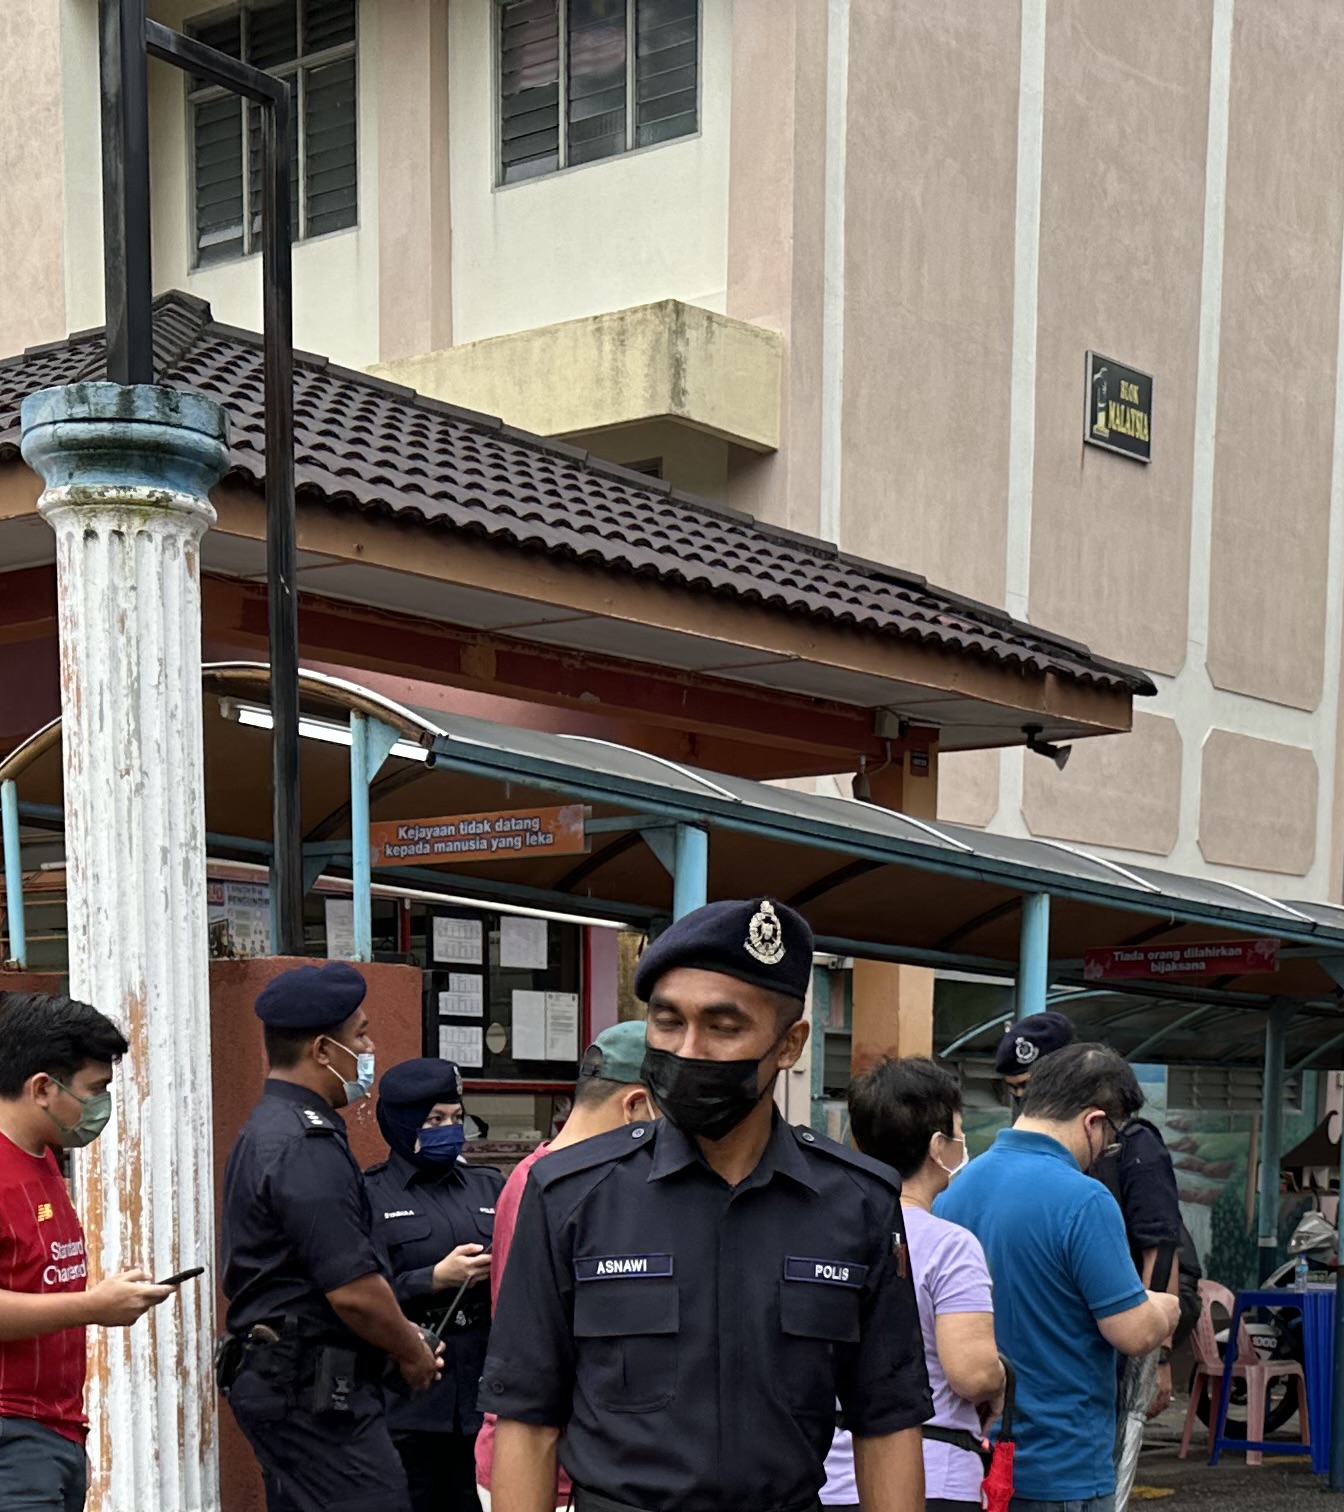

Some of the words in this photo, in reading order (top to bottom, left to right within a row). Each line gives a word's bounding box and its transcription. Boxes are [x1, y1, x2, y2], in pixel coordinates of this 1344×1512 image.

[1108, 400, 1149, 442] MALAYSIA
[398, 824, 456, 840] Kejayaan
[459, 821, 492, 834] tidak
[495, 817, 540, 833] datang
[385, 843, 431, 857] kepada
[434, 838, 488, 853] manusia
[491, 836, 522, 851] yang
[525, 832, 554, 846] leka
[1113, 951, 1145, 961] Tiada
[1147, 949, 1181, 961] orang
[1183, 946, 1243, 958] dilahirkan
[1150, 961, 1206, 974] bijaksana
[597, 1259, 647, 1274] ASNAWI
[815, 1264, 849, 1281] POLIS
